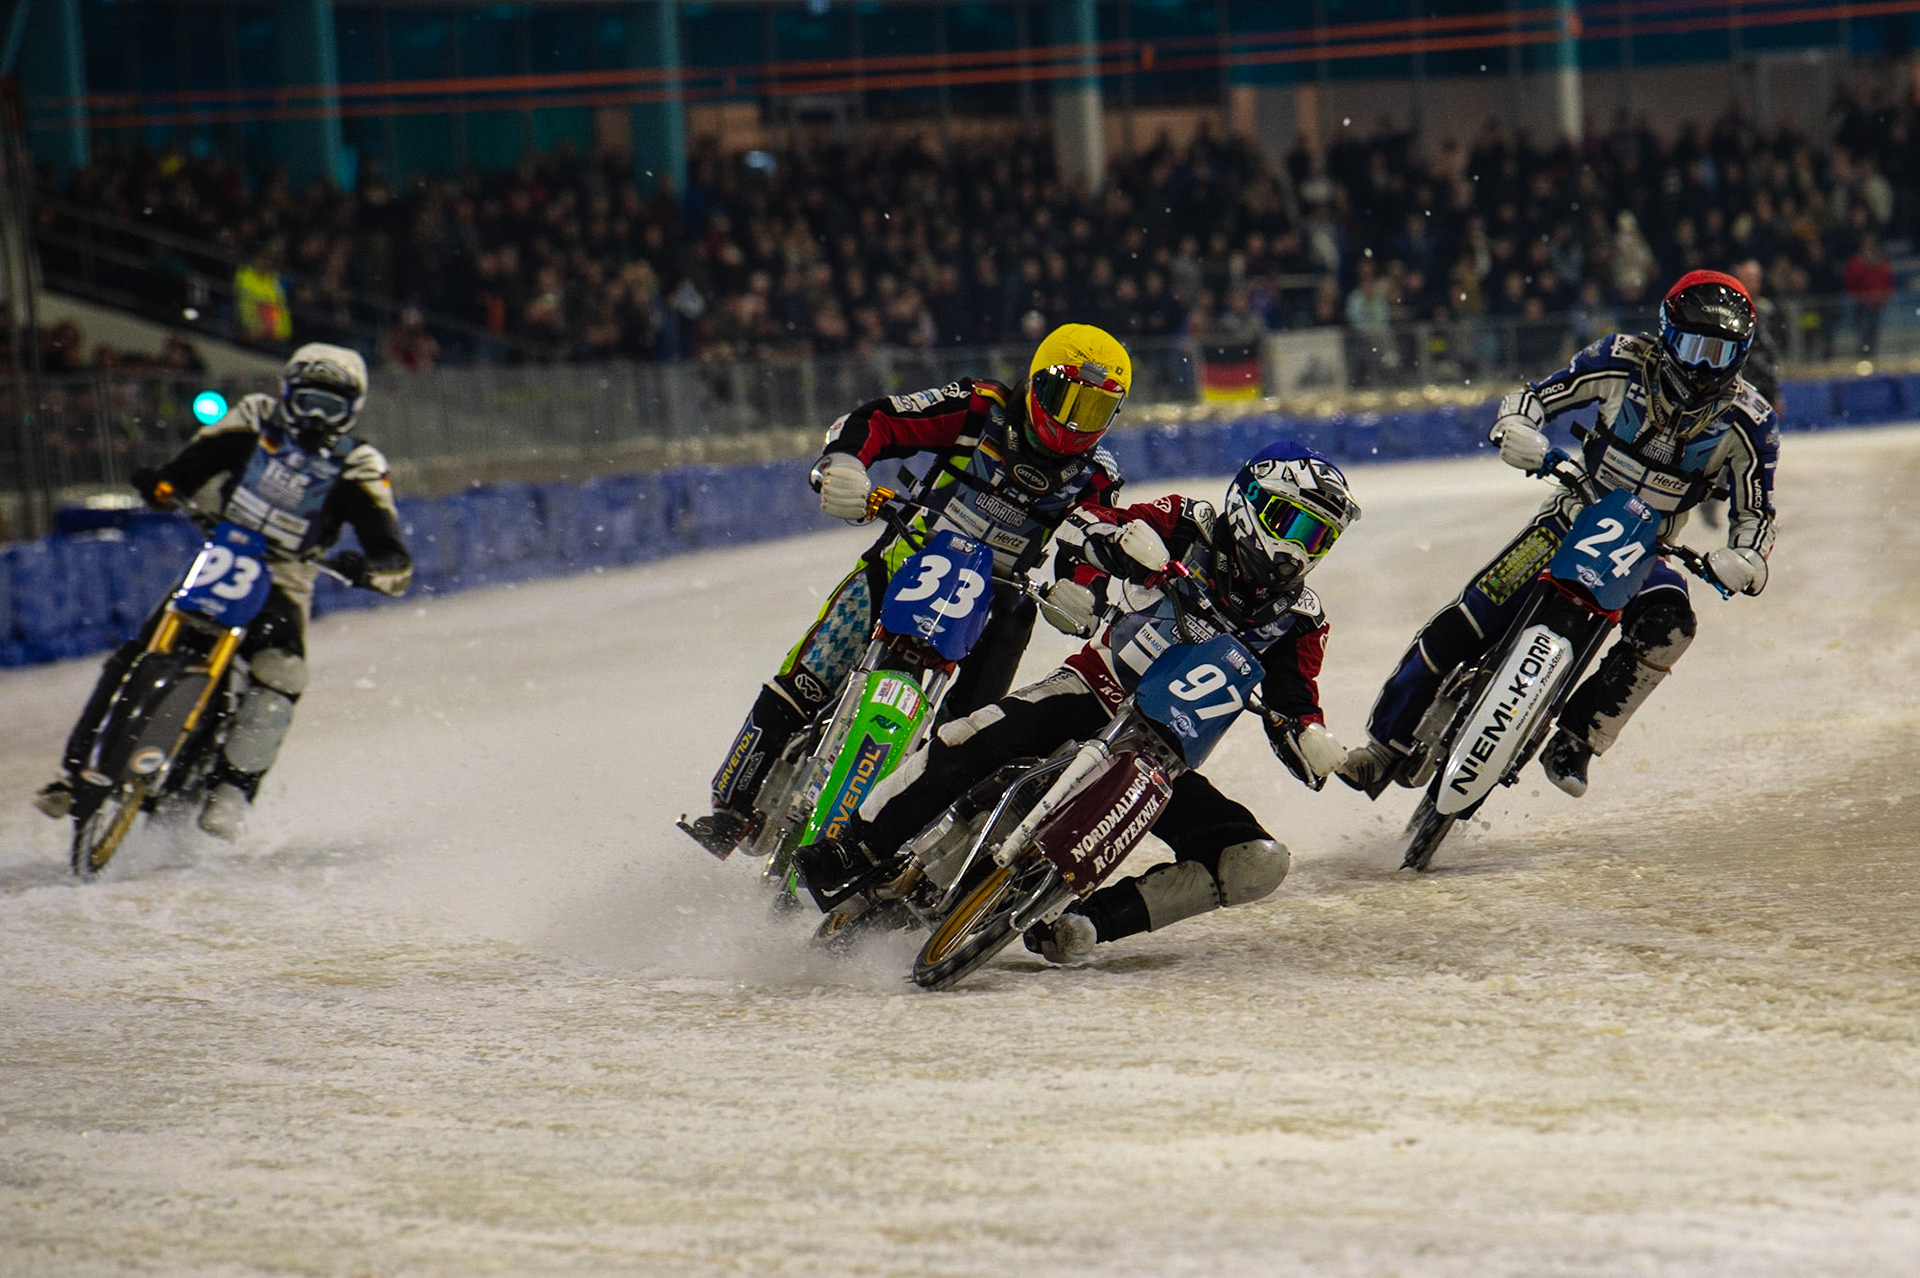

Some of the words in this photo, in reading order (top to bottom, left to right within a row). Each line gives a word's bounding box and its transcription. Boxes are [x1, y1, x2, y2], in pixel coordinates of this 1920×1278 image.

[1652, 473, 1685, 491] Hertz
[1753, 478, 1763, 509] WACO
[993, 531, 1024, 548] Hertz
[1574, 517, 1647, 578] 24
[183, 545, 262, 600] 93
[894, 554, 985, 619] 33
[1168, 663, 1244, 721] 97
[1450, 632, 1553, 796] NIEMI-KORPI
[717, 731, 755, 793] RAVENOL
[1070, 772, 1150, 863] NORDMALINGS
[1093, 793, 1161, 875] RÖRTEKNIK
